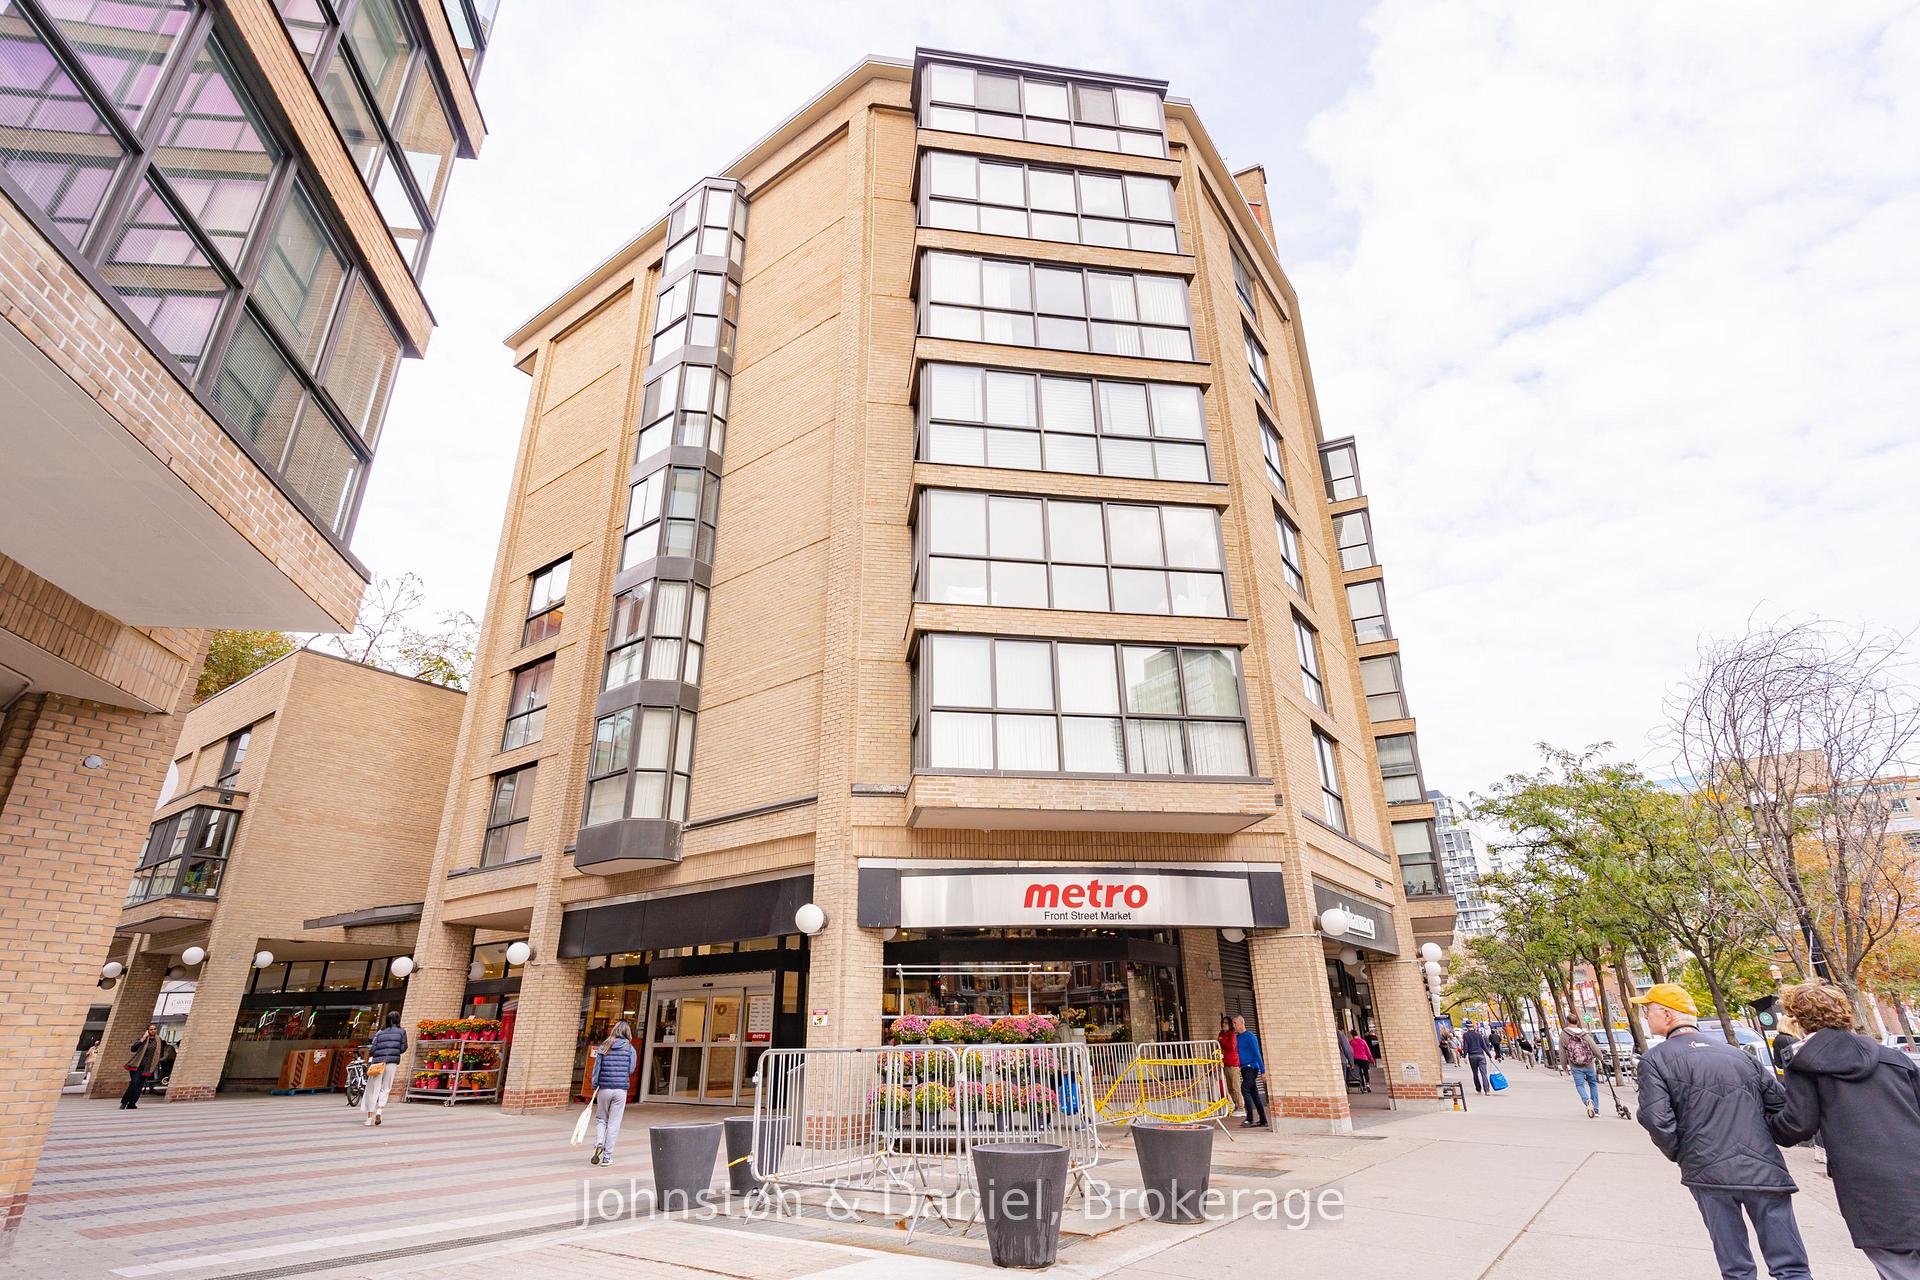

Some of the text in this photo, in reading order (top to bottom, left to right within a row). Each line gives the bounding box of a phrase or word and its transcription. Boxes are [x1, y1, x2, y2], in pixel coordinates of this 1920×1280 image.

[1024, 879, 1148, 909] metro
[1044, 910, 1132, 921] Front Street Market
